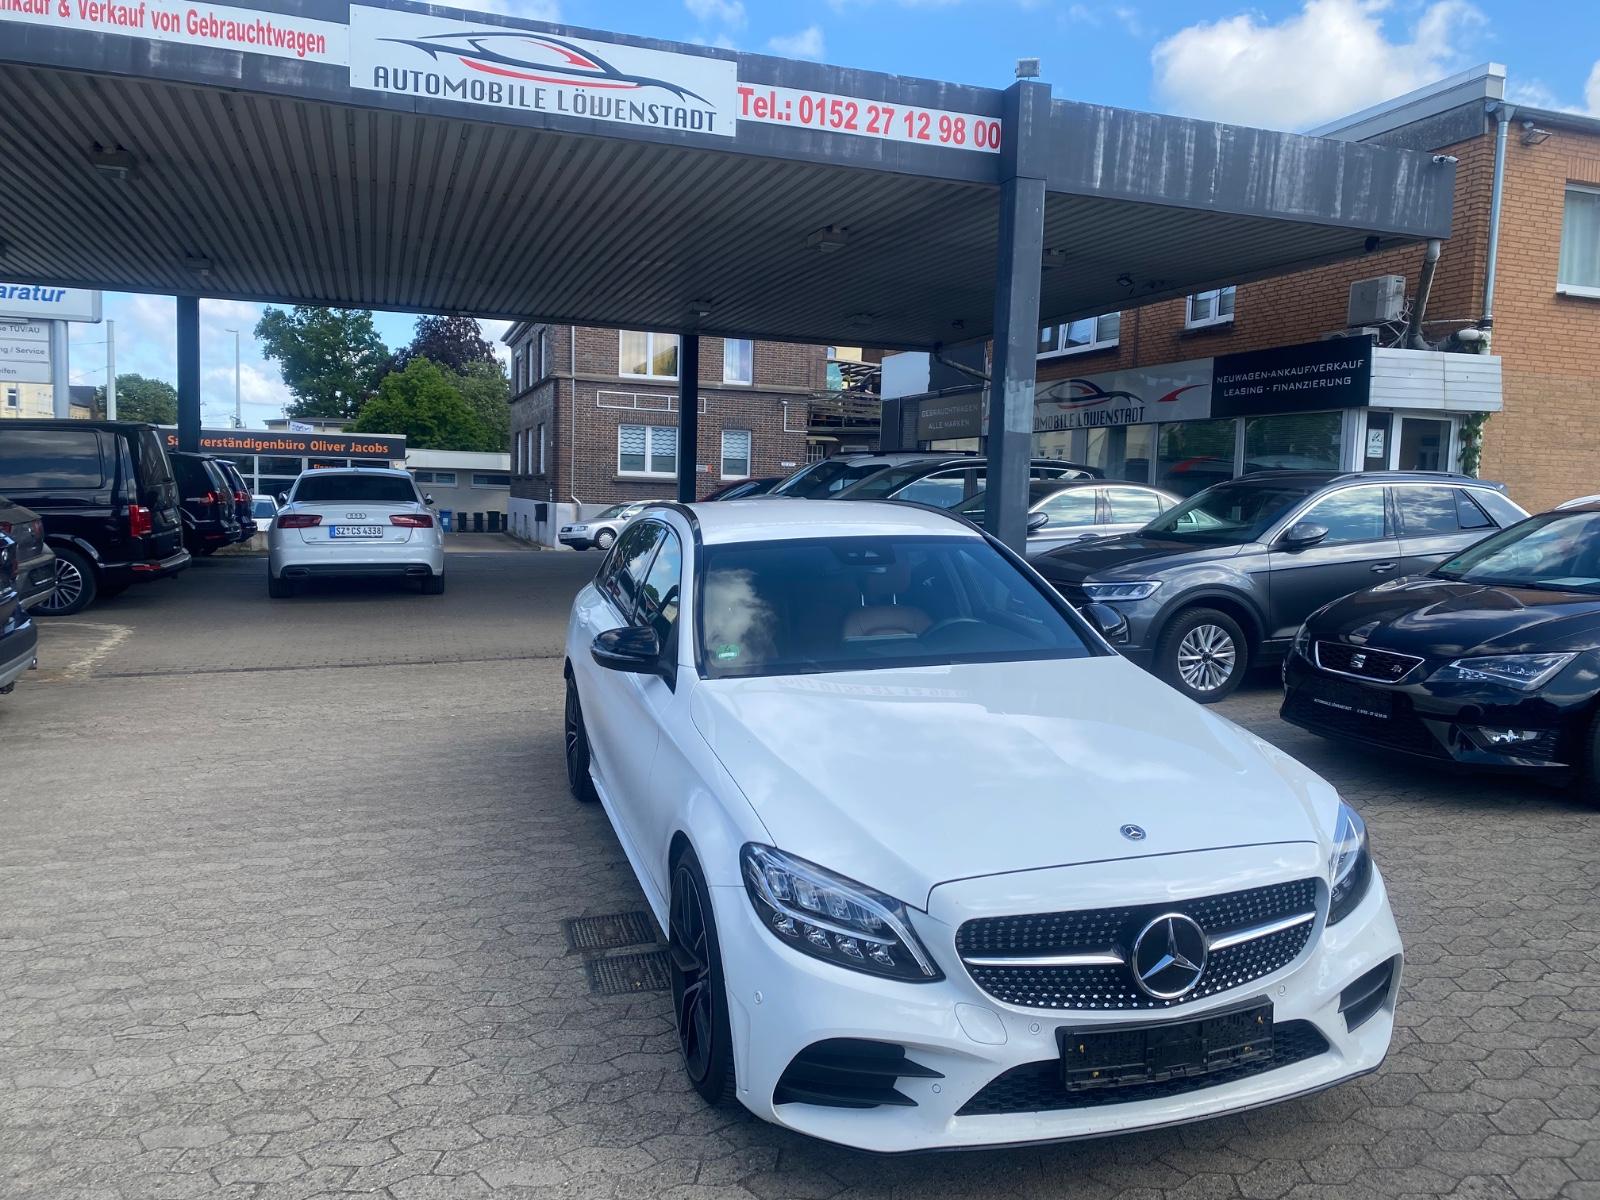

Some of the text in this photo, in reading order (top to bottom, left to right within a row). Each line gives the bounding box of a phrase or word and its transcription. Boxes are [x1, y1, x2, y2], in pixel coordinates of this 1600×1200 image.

[0, 0, 326, 57] nkauf & Verkauf von Gebrauchtwagen
[374, 65, 717, 132] AUTOMOBILE LÖWENSTADT
[738, 86, 1000, 150] Tel.: 0152 27 12 98 00
[15, 346, 46, 355] Service
[1223, 385, 1264, 397] LEASING
[1272, 376, 1352, 392] FINANZIERUNG
[1033, 406, 1146, 431] OMOBILE LÖWENSTADT
[310, 440, 346, 452] Oliver
[350, 442, 389, 453] Jacobs
[336, 526, 382, 535] SZ CS 4338
